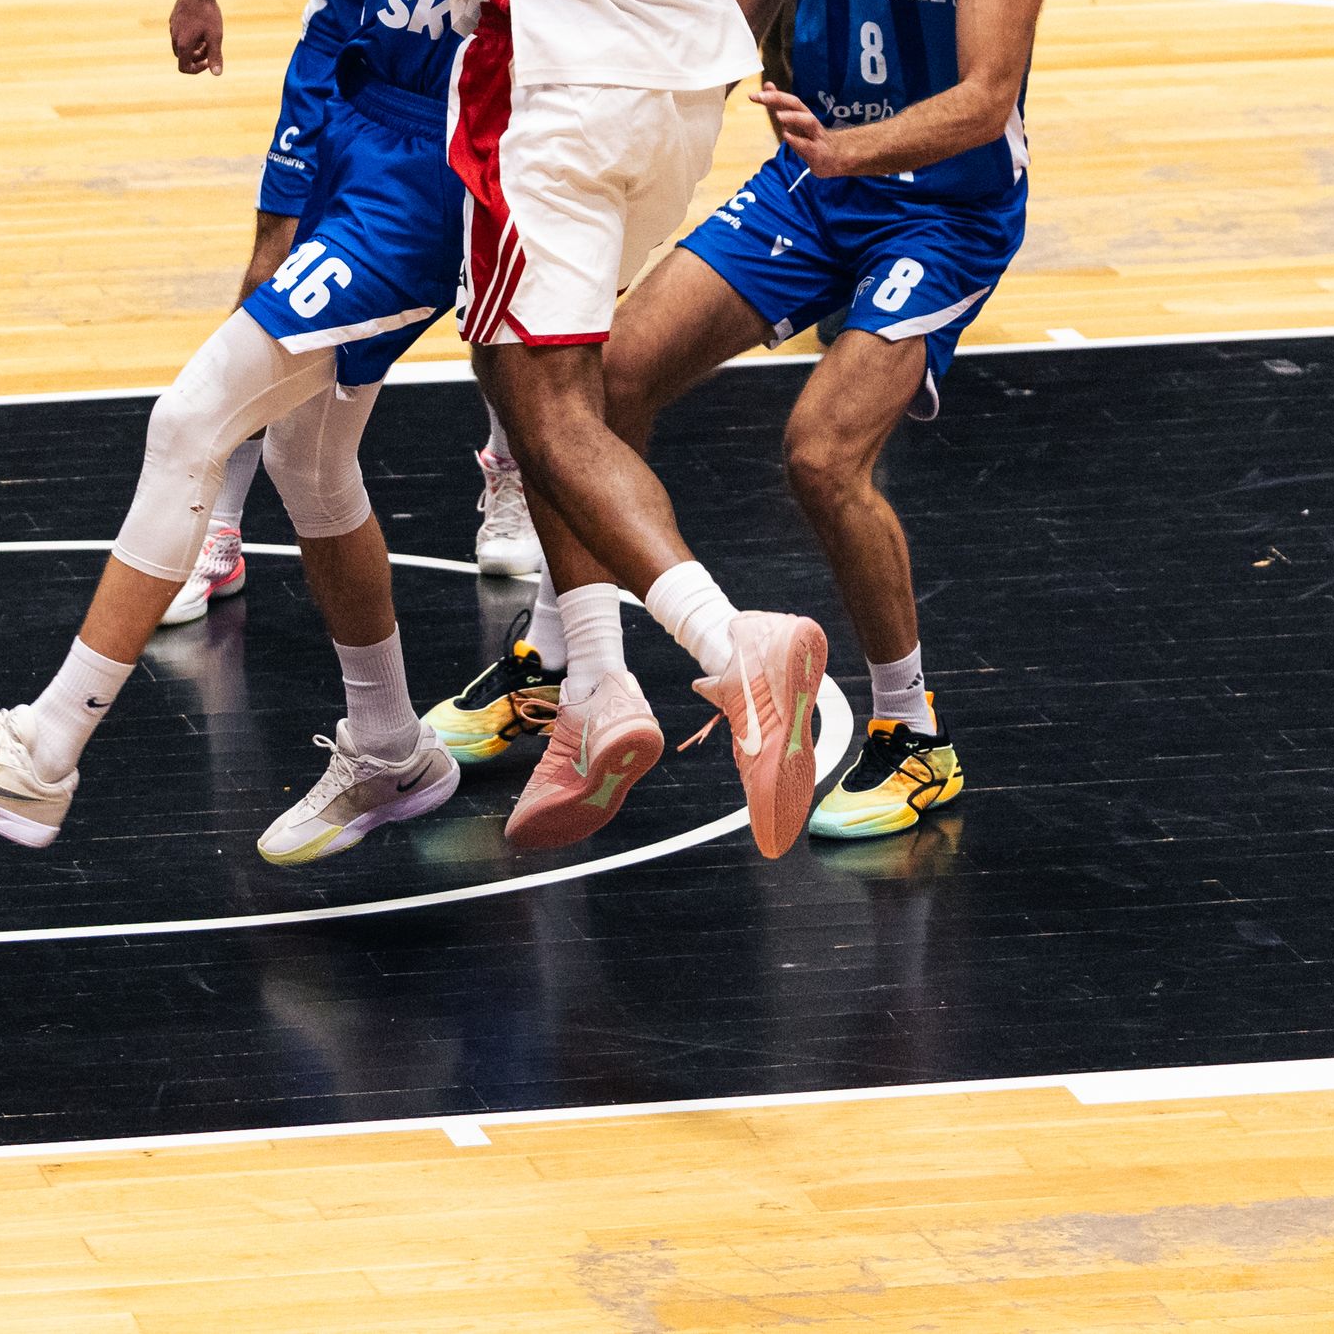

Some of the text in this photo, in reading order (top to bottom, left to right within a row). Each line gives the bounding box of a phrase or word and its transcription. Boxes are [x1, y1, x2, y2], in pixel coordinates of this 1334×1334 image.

[860, 21, 888, 85] 8
[271, 239, 353, 319] 46
[872, 256, 925, 313] 8
